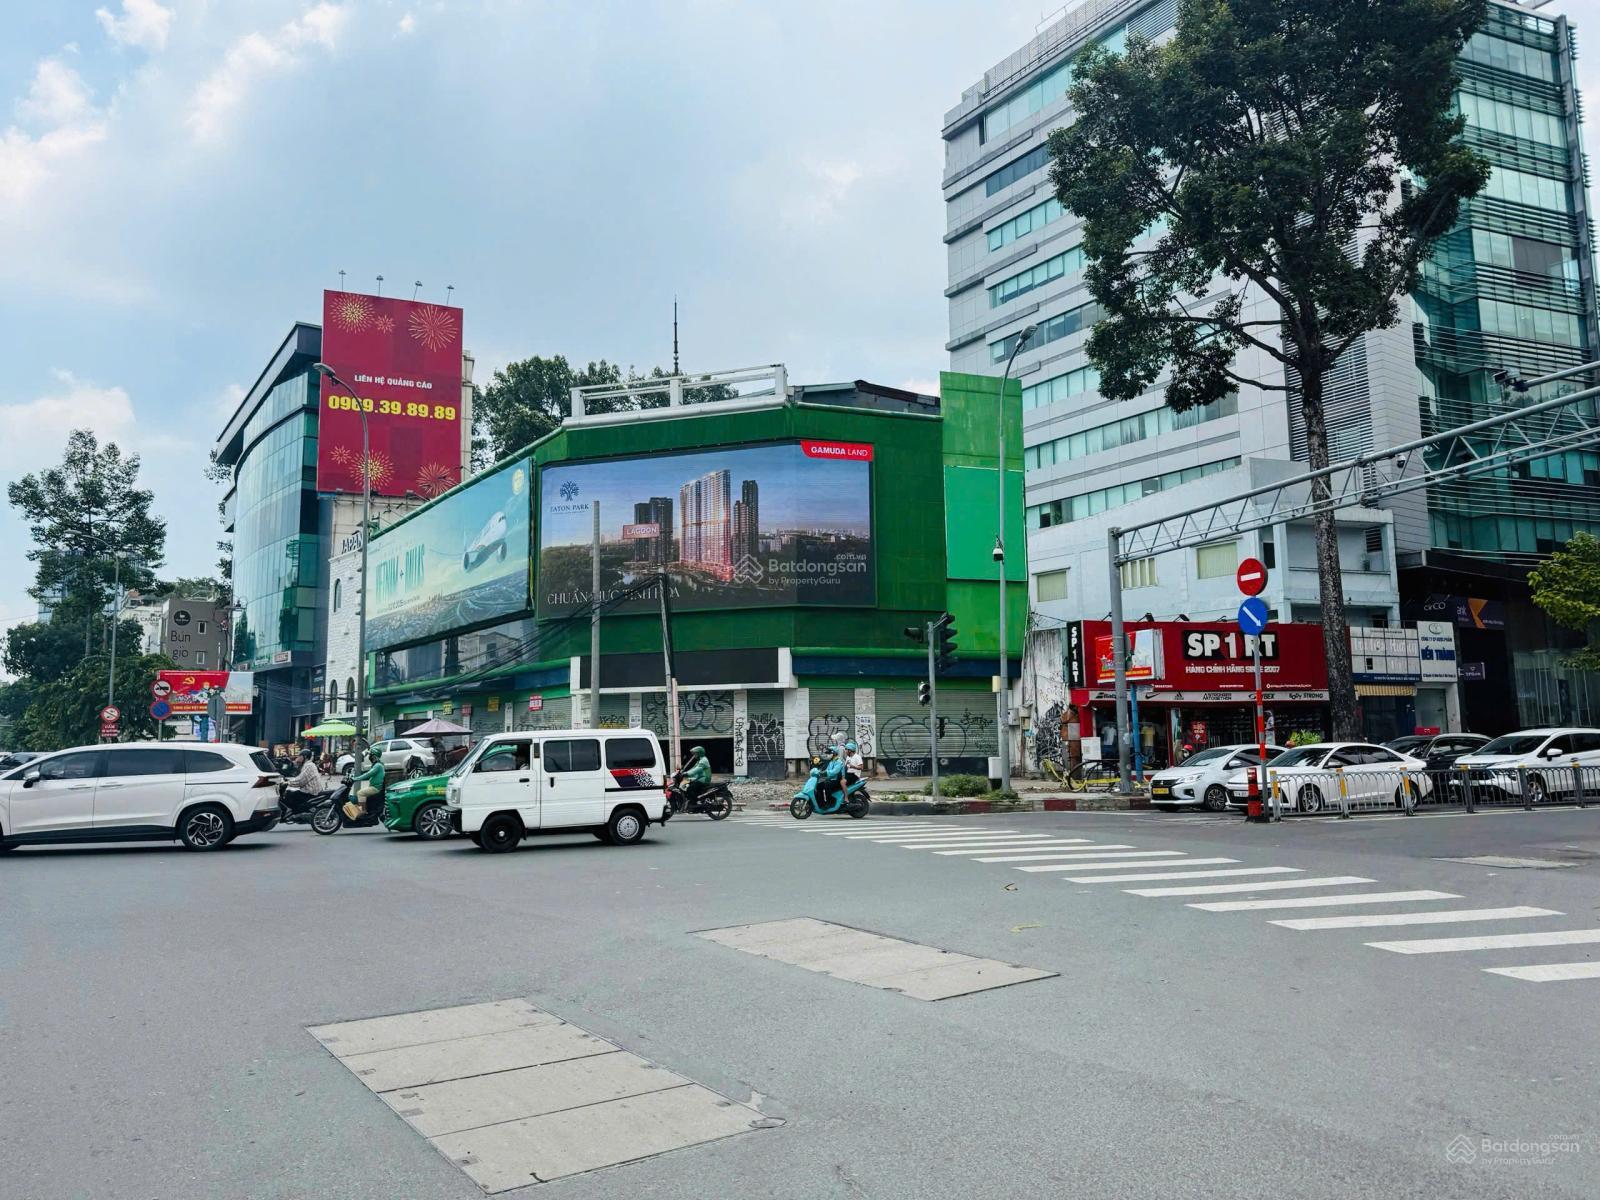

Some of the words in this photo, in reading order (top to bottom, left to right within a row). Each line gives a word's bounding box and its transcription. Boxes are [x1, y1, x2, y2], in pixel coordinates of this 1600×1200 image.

[354, 374, 373, 384] LIÊN
[374, 375, 386, 387] HỆ
[415, 378, 433, 390] CÁO
[328, 395, 456, 420] 0969.39.89.89
[810, 446, 846, 455] GAMUDA
[847, 449, 868, 457] LAND
[572, 503, 590, 511] PARK
[626, 526, 657, 536] LAGOON
[1187, 632, 1276, 659] SP1RT
[1071, 626, 1079, 683] SP1RT
[1264, 665, 1281, 673] 2007
